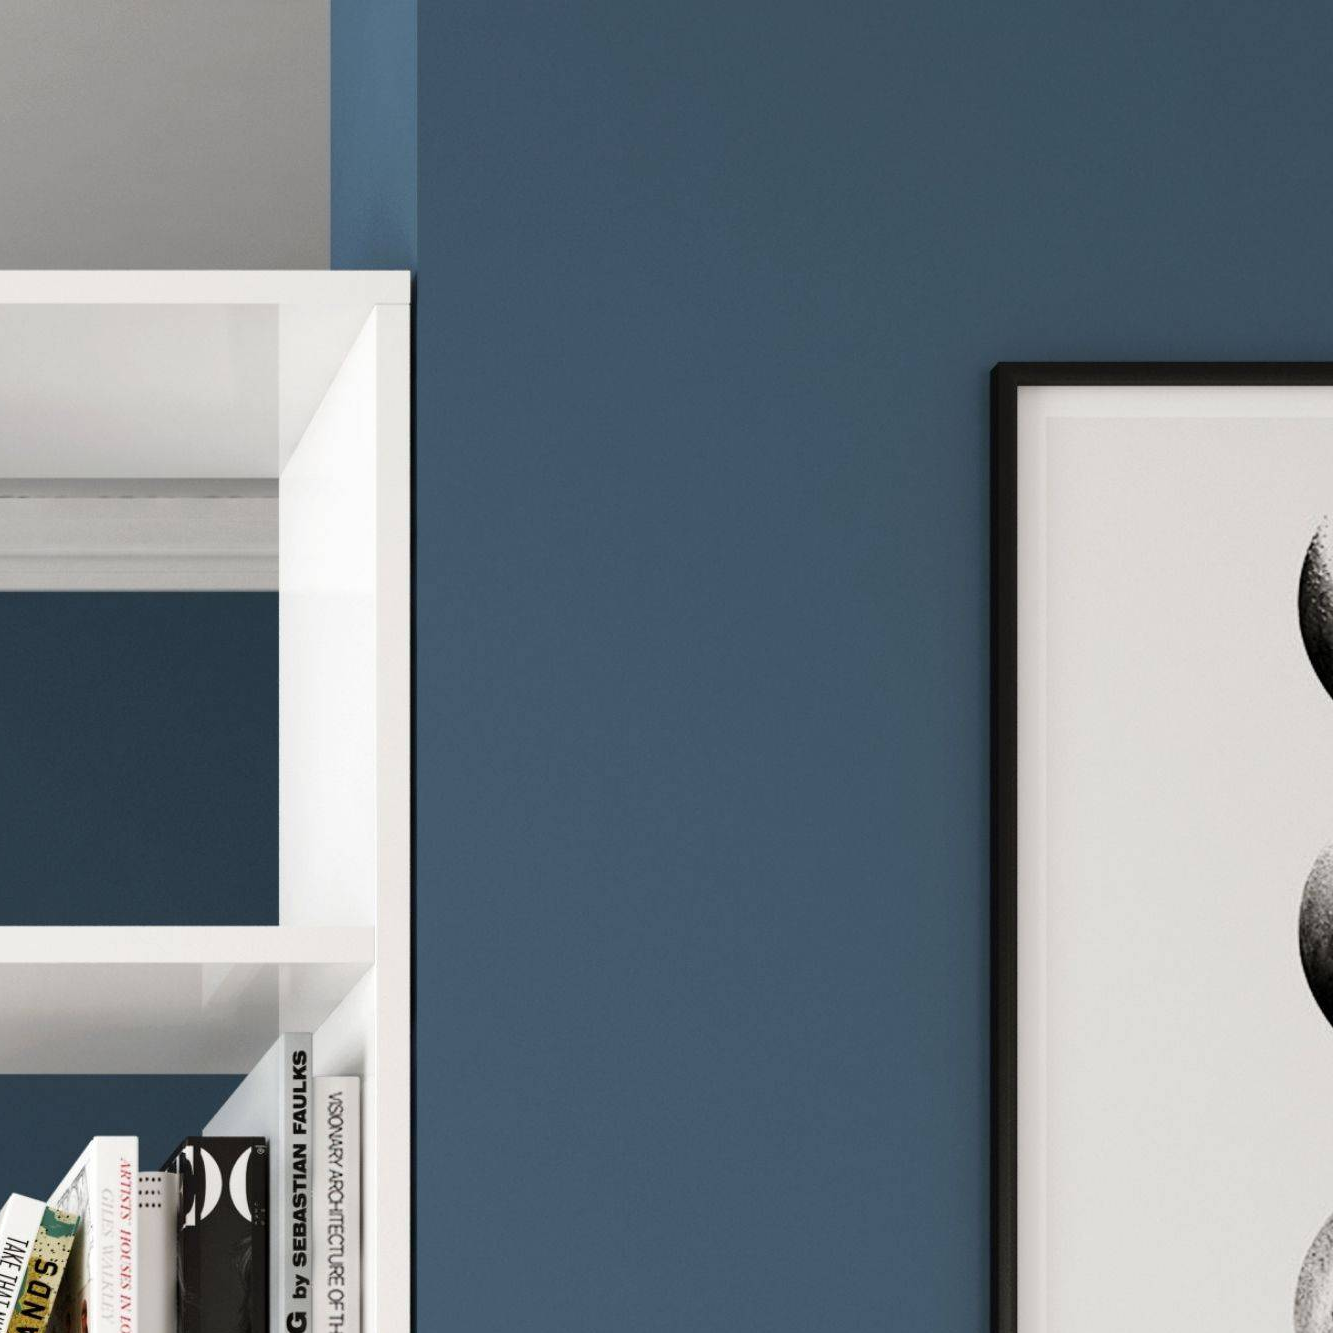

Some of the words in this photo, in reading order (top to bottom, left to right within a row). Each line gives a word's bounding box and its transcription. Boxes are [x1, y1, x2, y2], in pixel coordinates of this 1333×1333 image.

[293, 1050, 307, 1134] FAULKS
[327, 1091, 345, 1167] VISIONARY
[293, 1144, 307, 1267] SEBASTIAN
[327, 1169, 345, 1287] ARCHITECTURE
[120, 1229, 132, 1290] HOUSES
[293, 1274, 311, 1298] by
[120, 1294, 132, 1312] IN
[327, 1289, 345, 1311] OF
